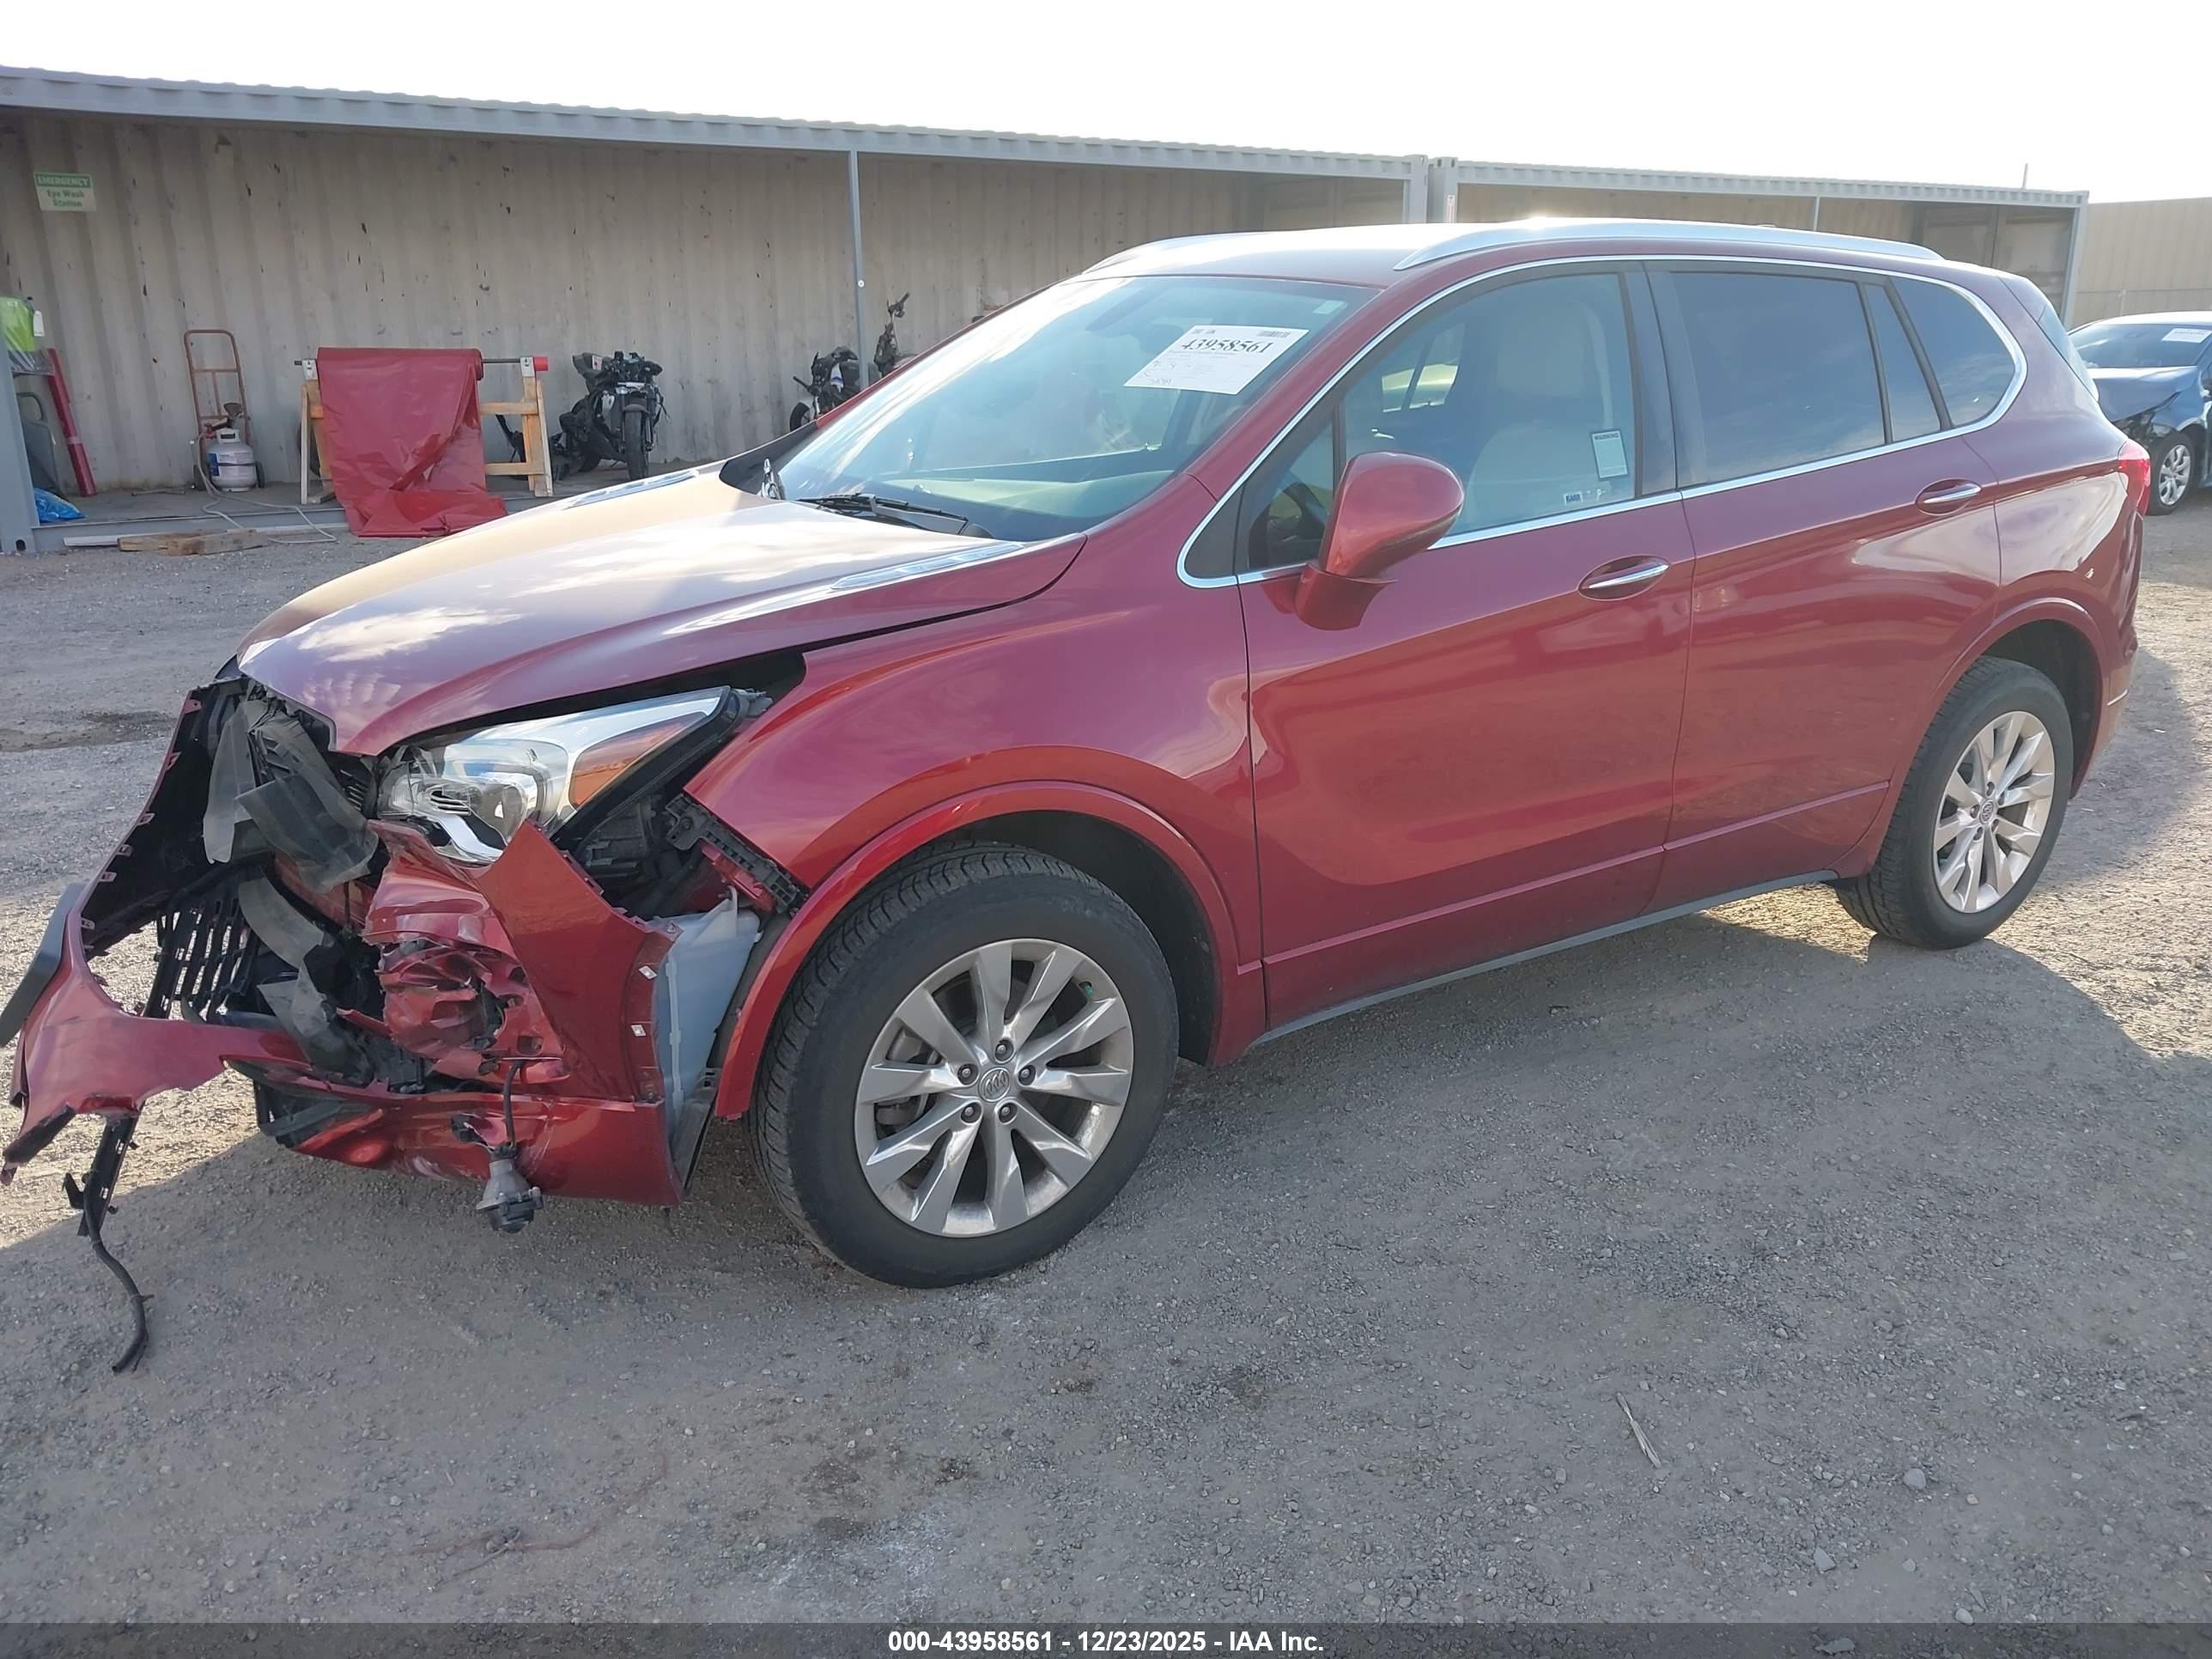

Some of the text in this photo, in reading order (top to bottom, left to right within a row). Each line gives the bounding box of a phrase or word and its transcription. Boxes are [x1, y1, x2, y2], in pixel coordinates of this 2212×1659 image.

[37, 175, 89, 186] EMERGENCY
[53, 198, 83, 207] Station
[1182, 338, 1274, 354] 43958561
